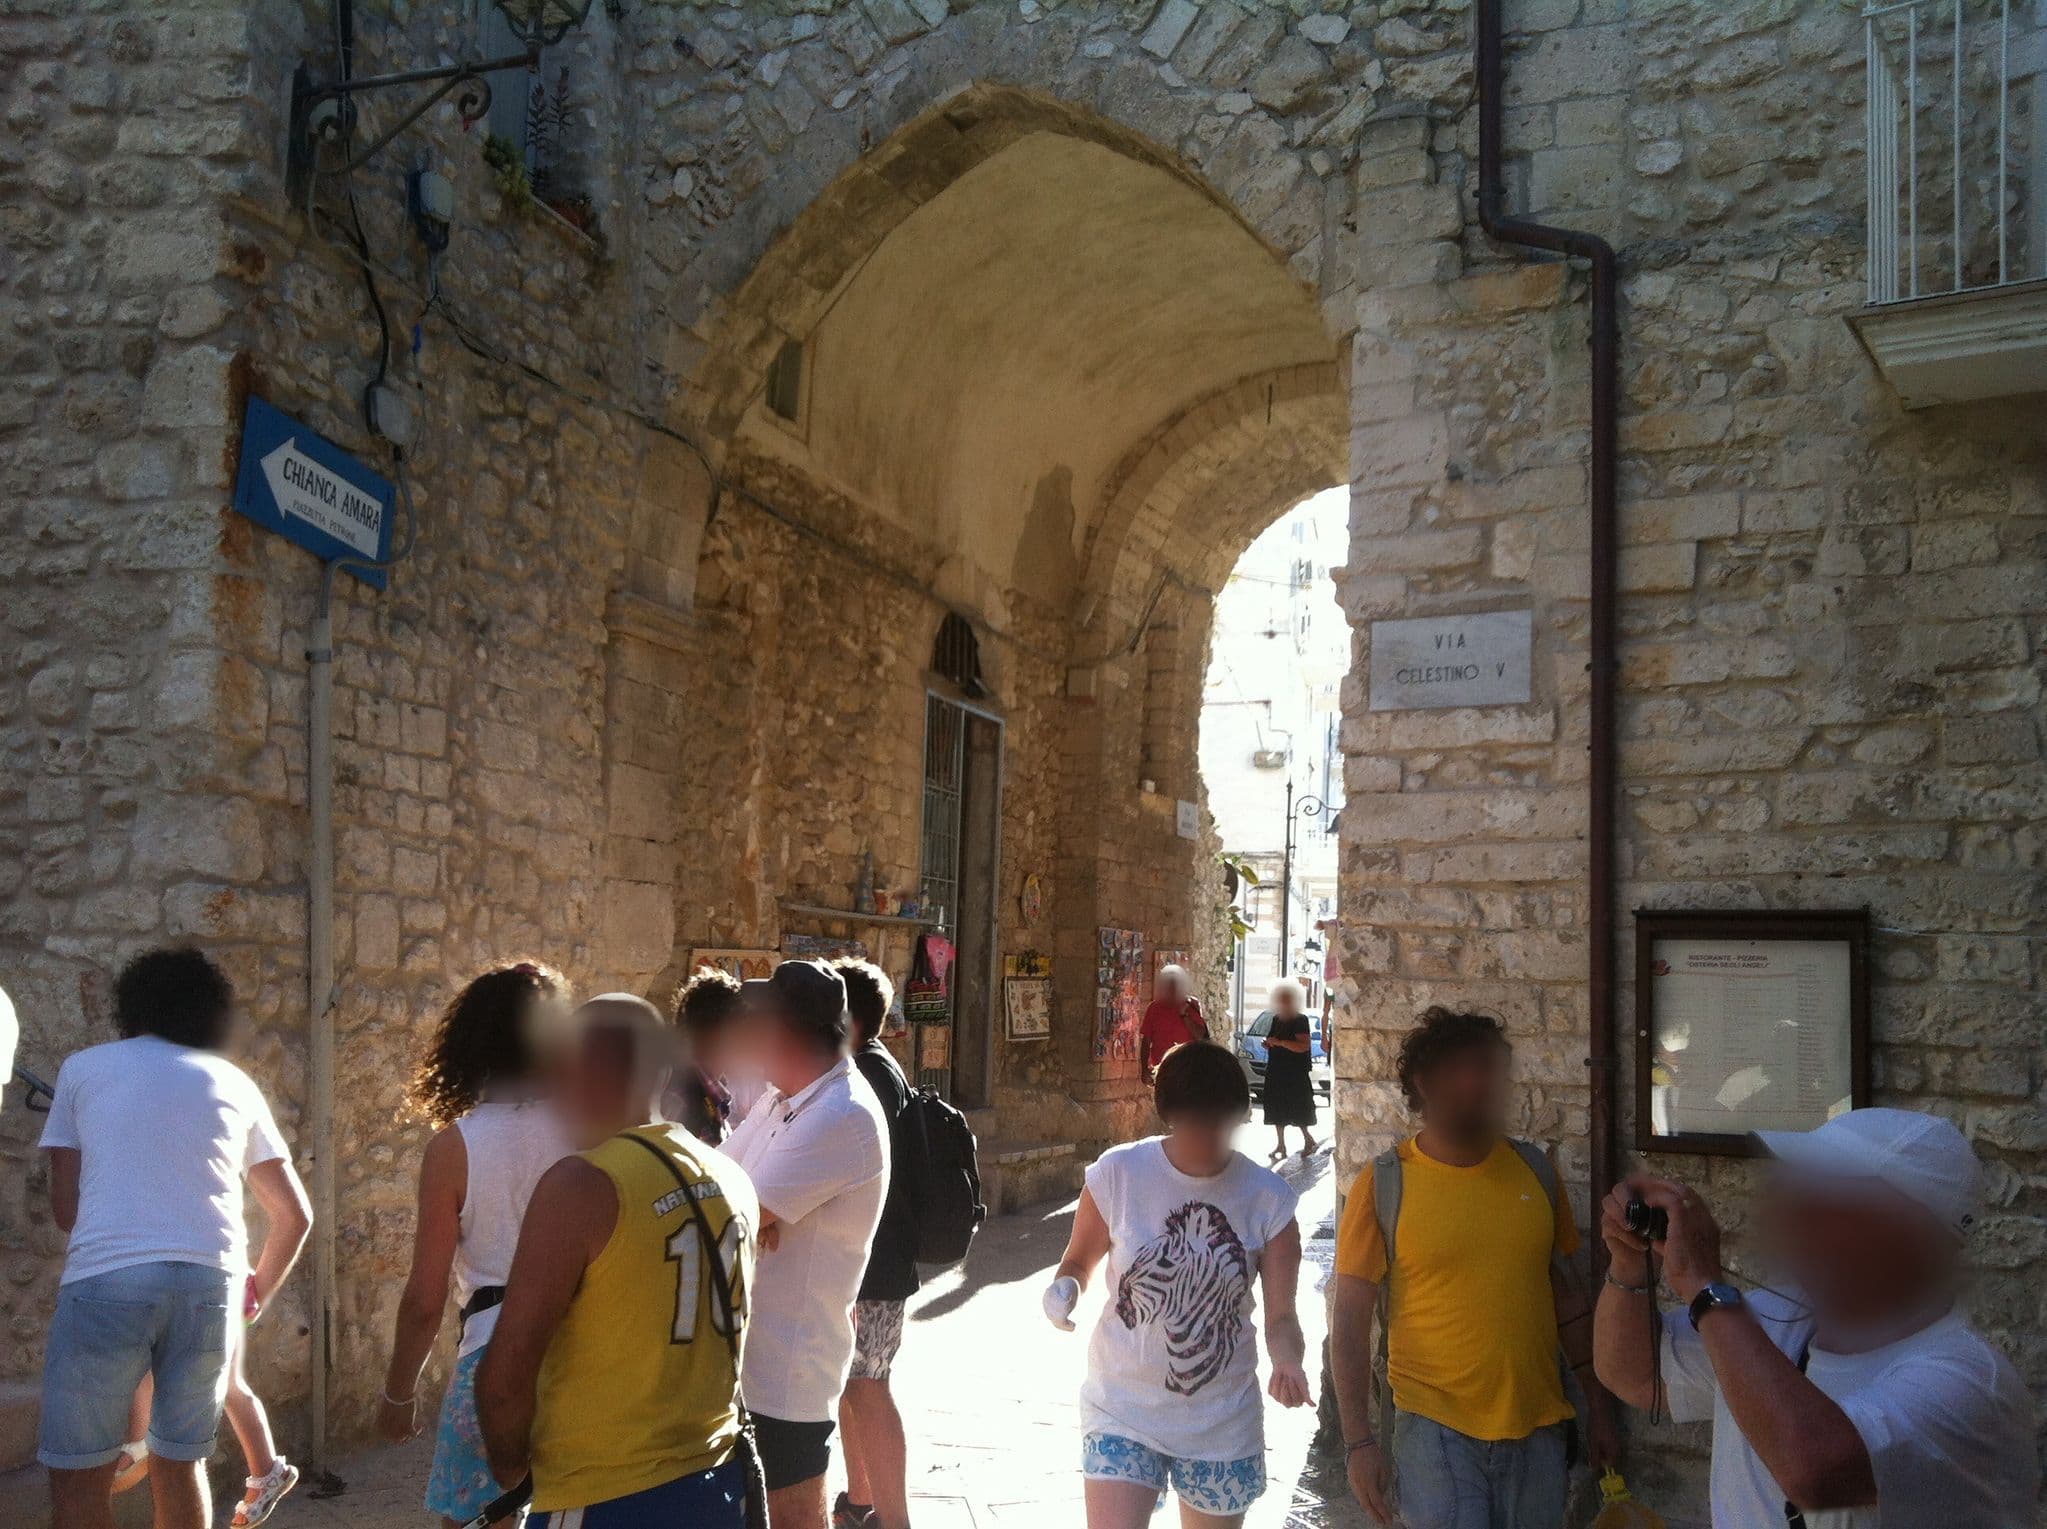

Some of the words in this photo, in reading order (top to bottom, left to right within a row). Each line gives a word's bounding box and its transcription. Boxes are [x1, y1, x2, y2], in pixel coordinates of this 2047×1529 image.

[283, 457, 337, 509] CHIANCA
[341, 492, 379, 533] AMARA
[1434, 633, 1466, 649] VIA
[1394, 664, 1480, 686] CELESTINO
[1495, 661, 1506, 677] V
